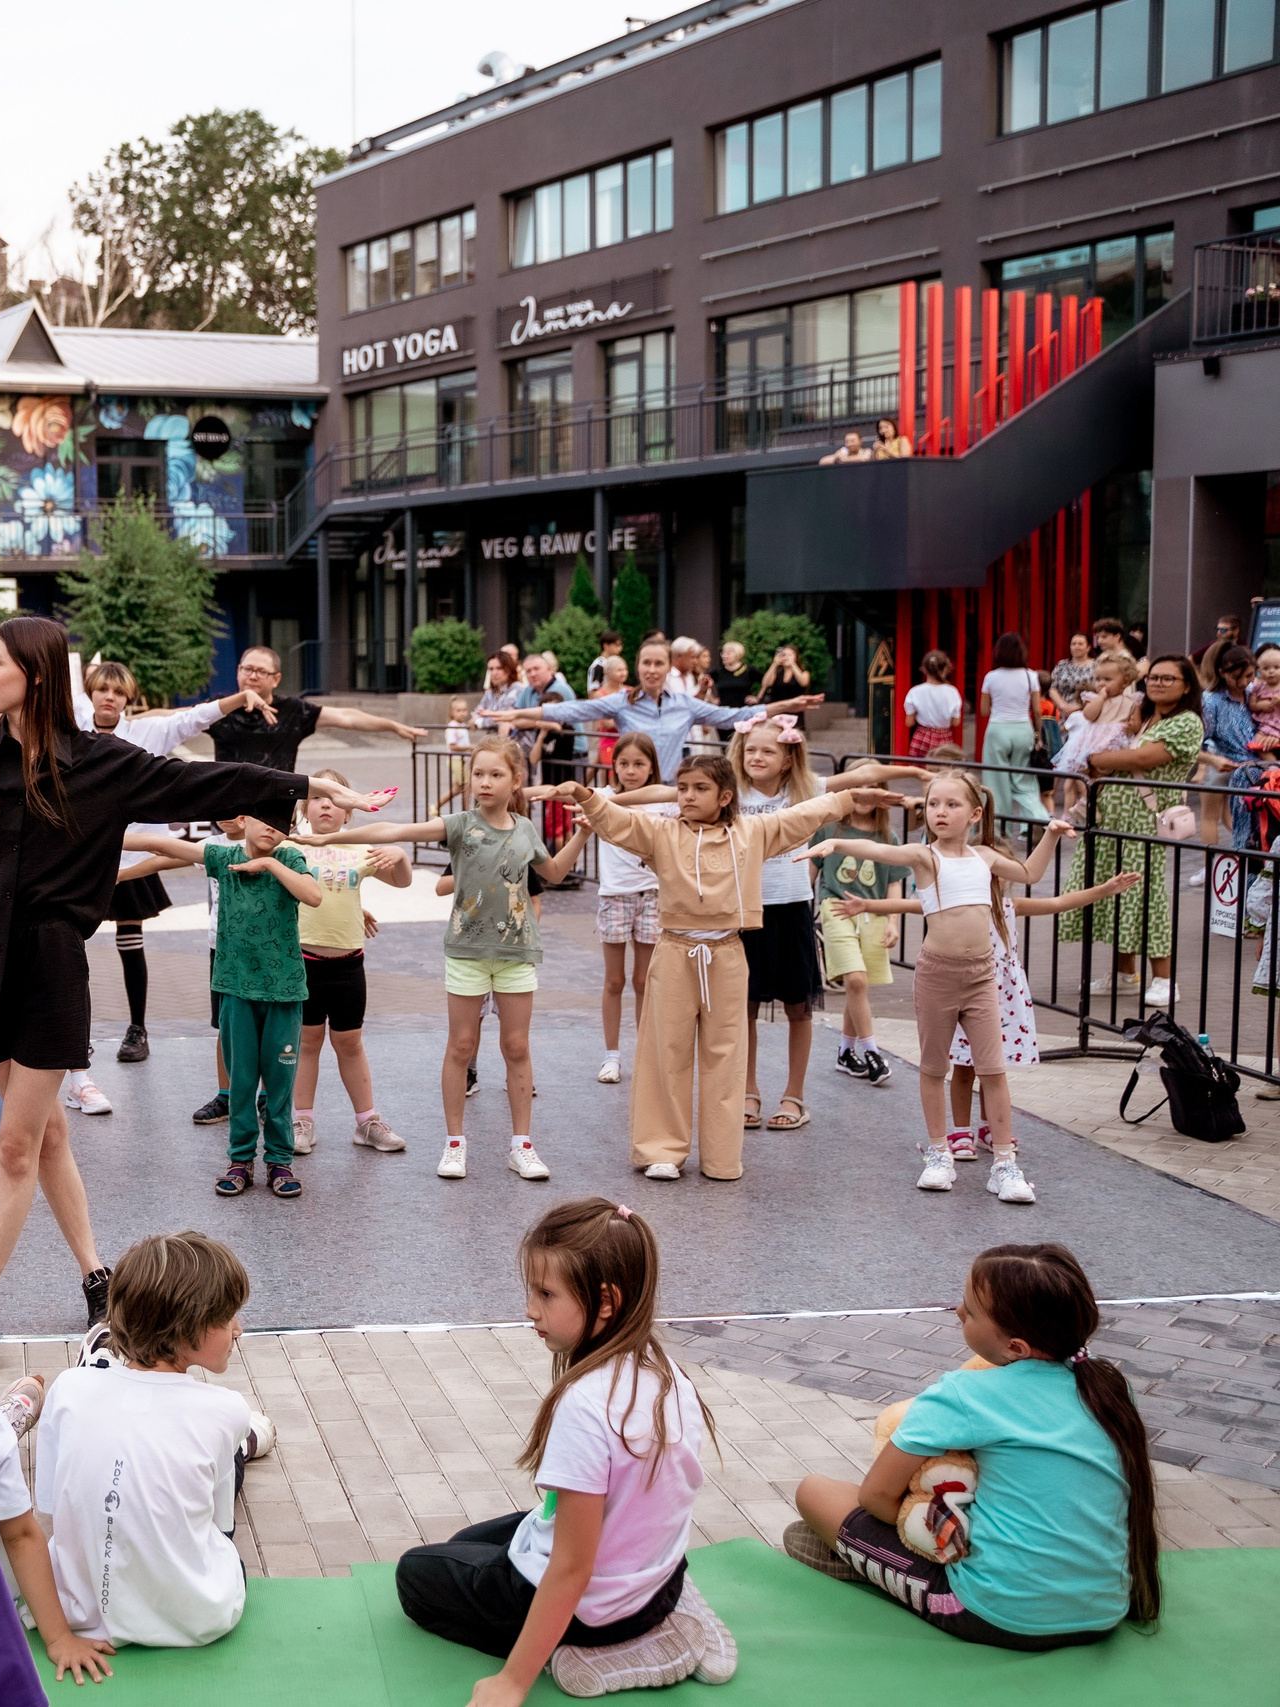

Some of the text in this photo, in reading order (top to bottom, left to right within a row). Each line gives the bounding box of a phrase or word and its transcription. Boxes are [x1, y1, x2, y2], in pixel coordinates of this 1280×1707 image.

[543, 306, 565, 321] HOT
[342, 324, 459, 376] HOT YOGA
[481, 527, 637, 559] VEG & RAW CFE
[303, 847, 358, 864] SUNNY
[1211, 917, 1236, 930] ЗАПРЕЩЕ
[112, 1459, 123, 1486] MDC
[101, 1516, 113, 1614] BLACK SCHOOL
